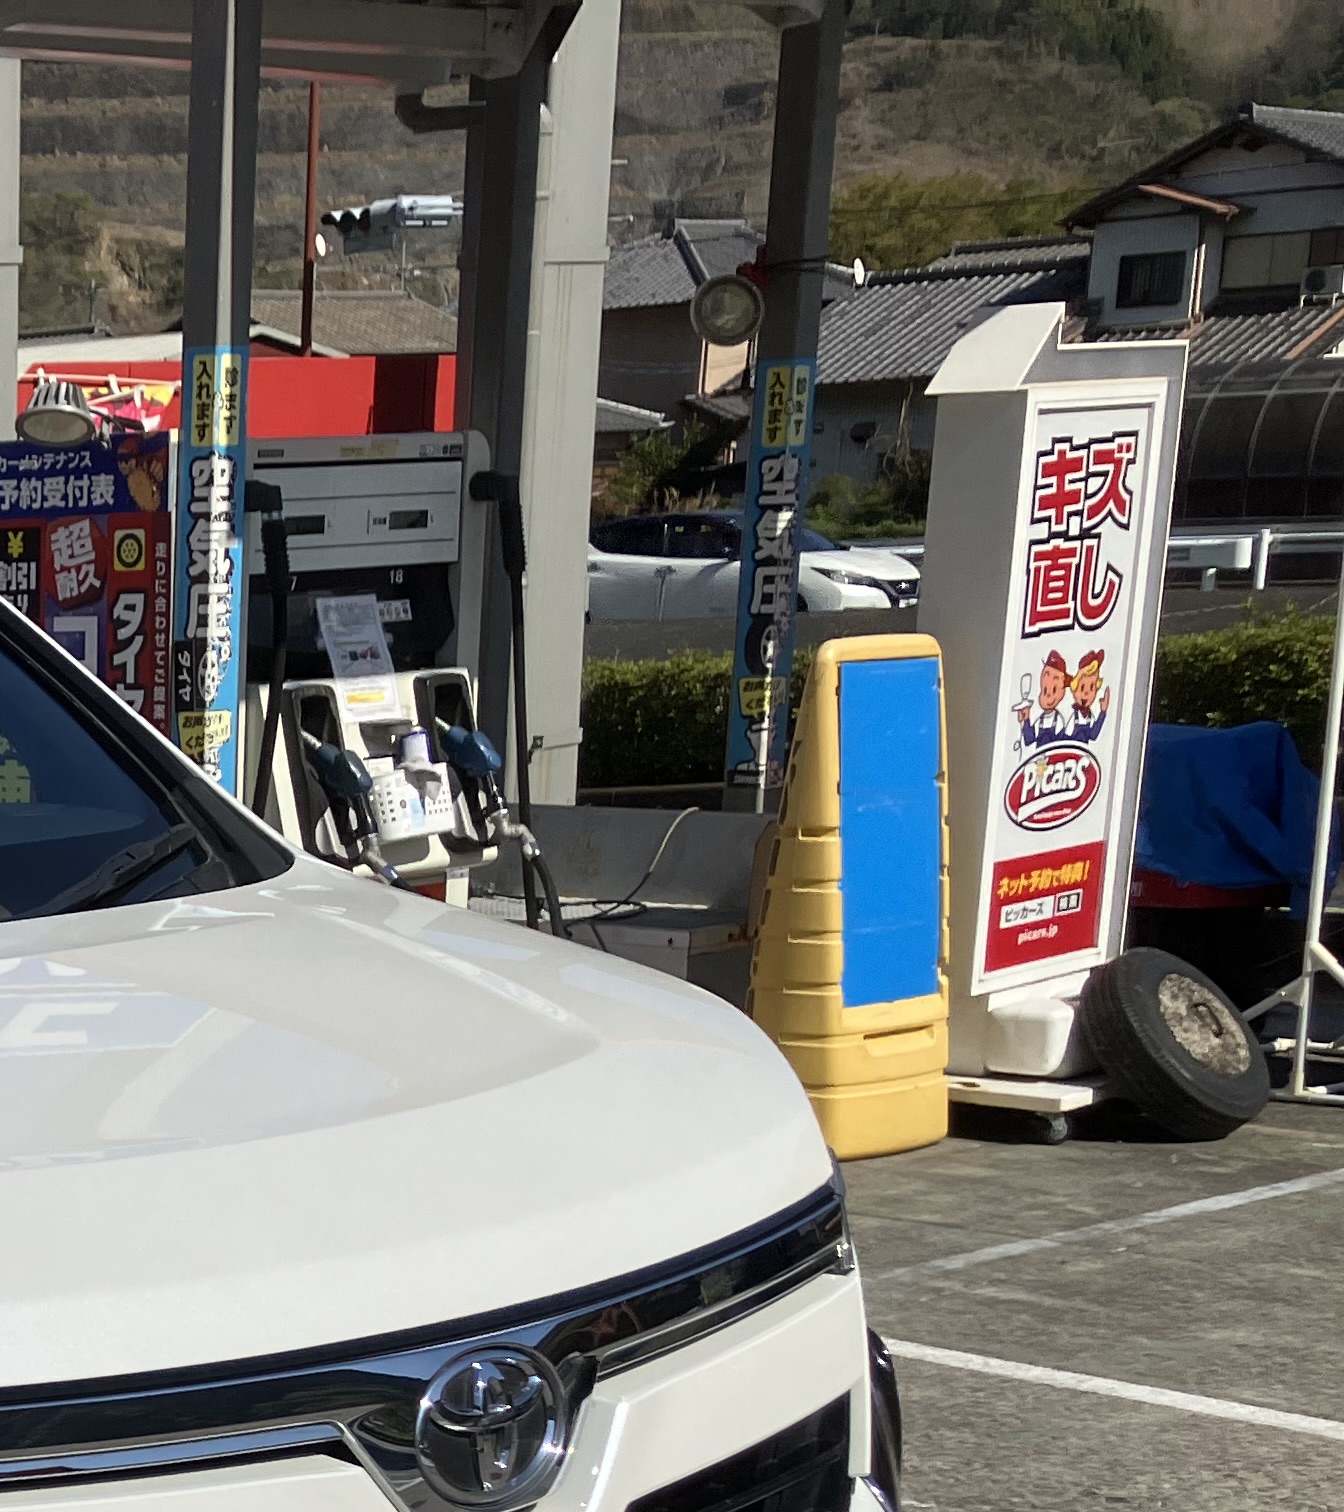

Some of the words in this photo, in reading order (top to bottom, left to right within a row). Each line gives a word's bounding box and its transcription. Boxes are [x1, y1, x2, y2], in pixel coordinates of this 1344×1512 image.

[193, 360, 212, 442] 入れます
[765, 371, 785, 444] 入れます
[1030, 430, 1139, 540] キズ
[50, 519, 96, 571] 超
[389, 569, 404, 585] 18
[54, 562, 101, 602] 耐久
[1021, 532, 1123, 640] 直し
